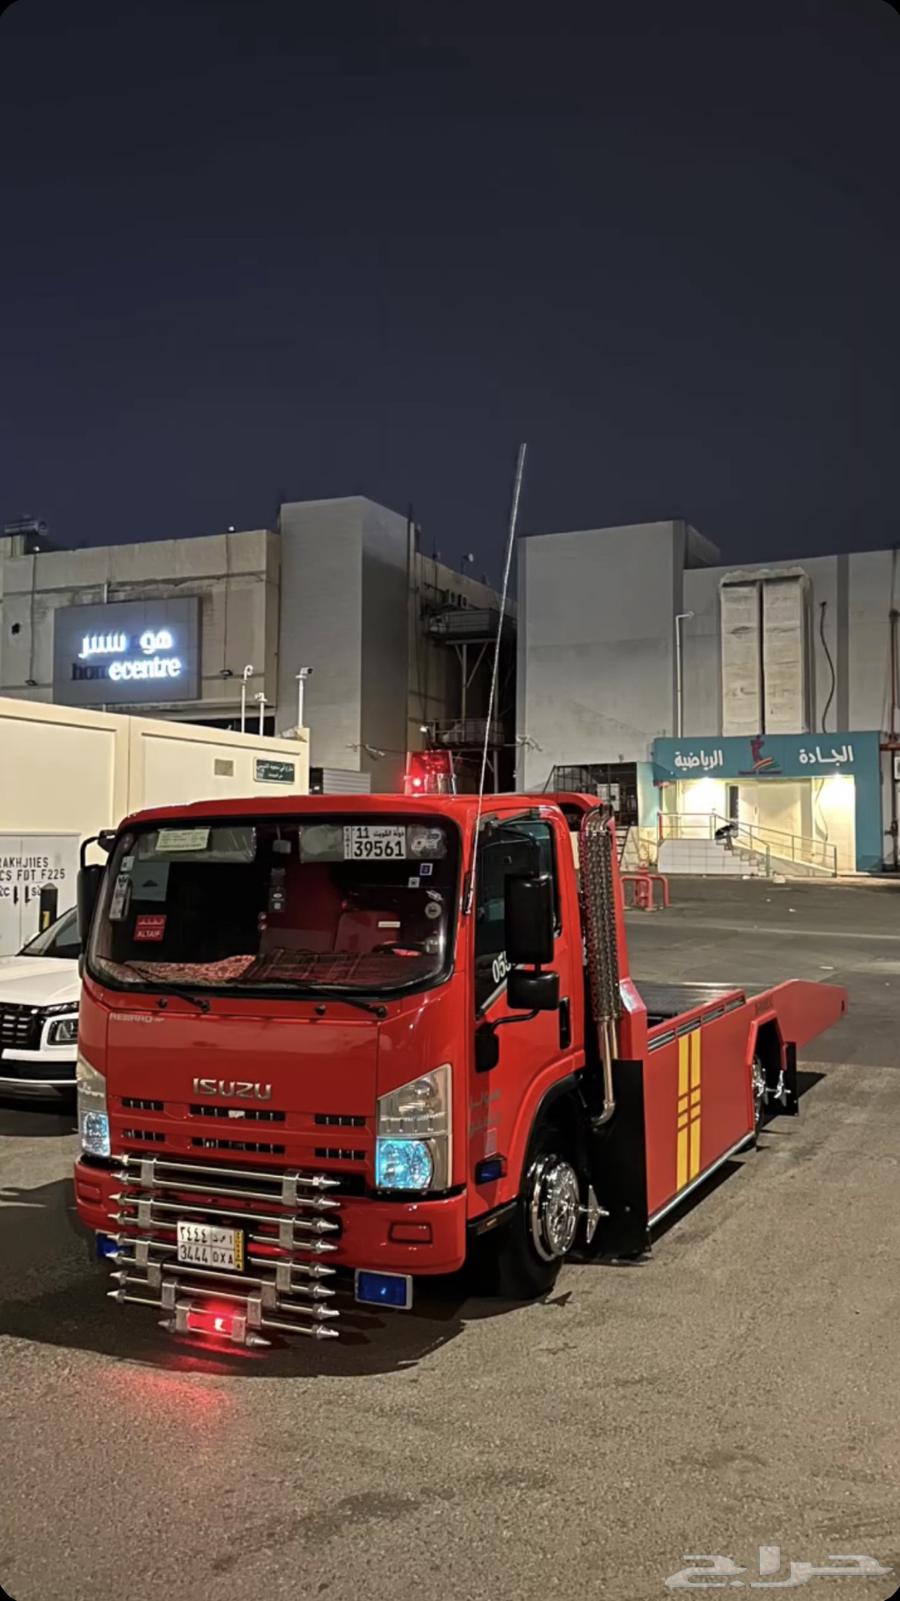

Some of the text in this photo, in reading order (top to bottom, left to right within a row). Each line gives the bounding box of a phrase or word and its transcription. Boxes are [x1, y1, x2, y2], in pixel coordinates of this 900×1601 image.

[674, 745, 854, 771] الجادة الرياضية
[356, 827, 369, 839] 11
[353, 840, 404, 857] 39561
[192, 1077, 272, 1100] ISUZU
[180, 1245, 208, 1262] 3444
